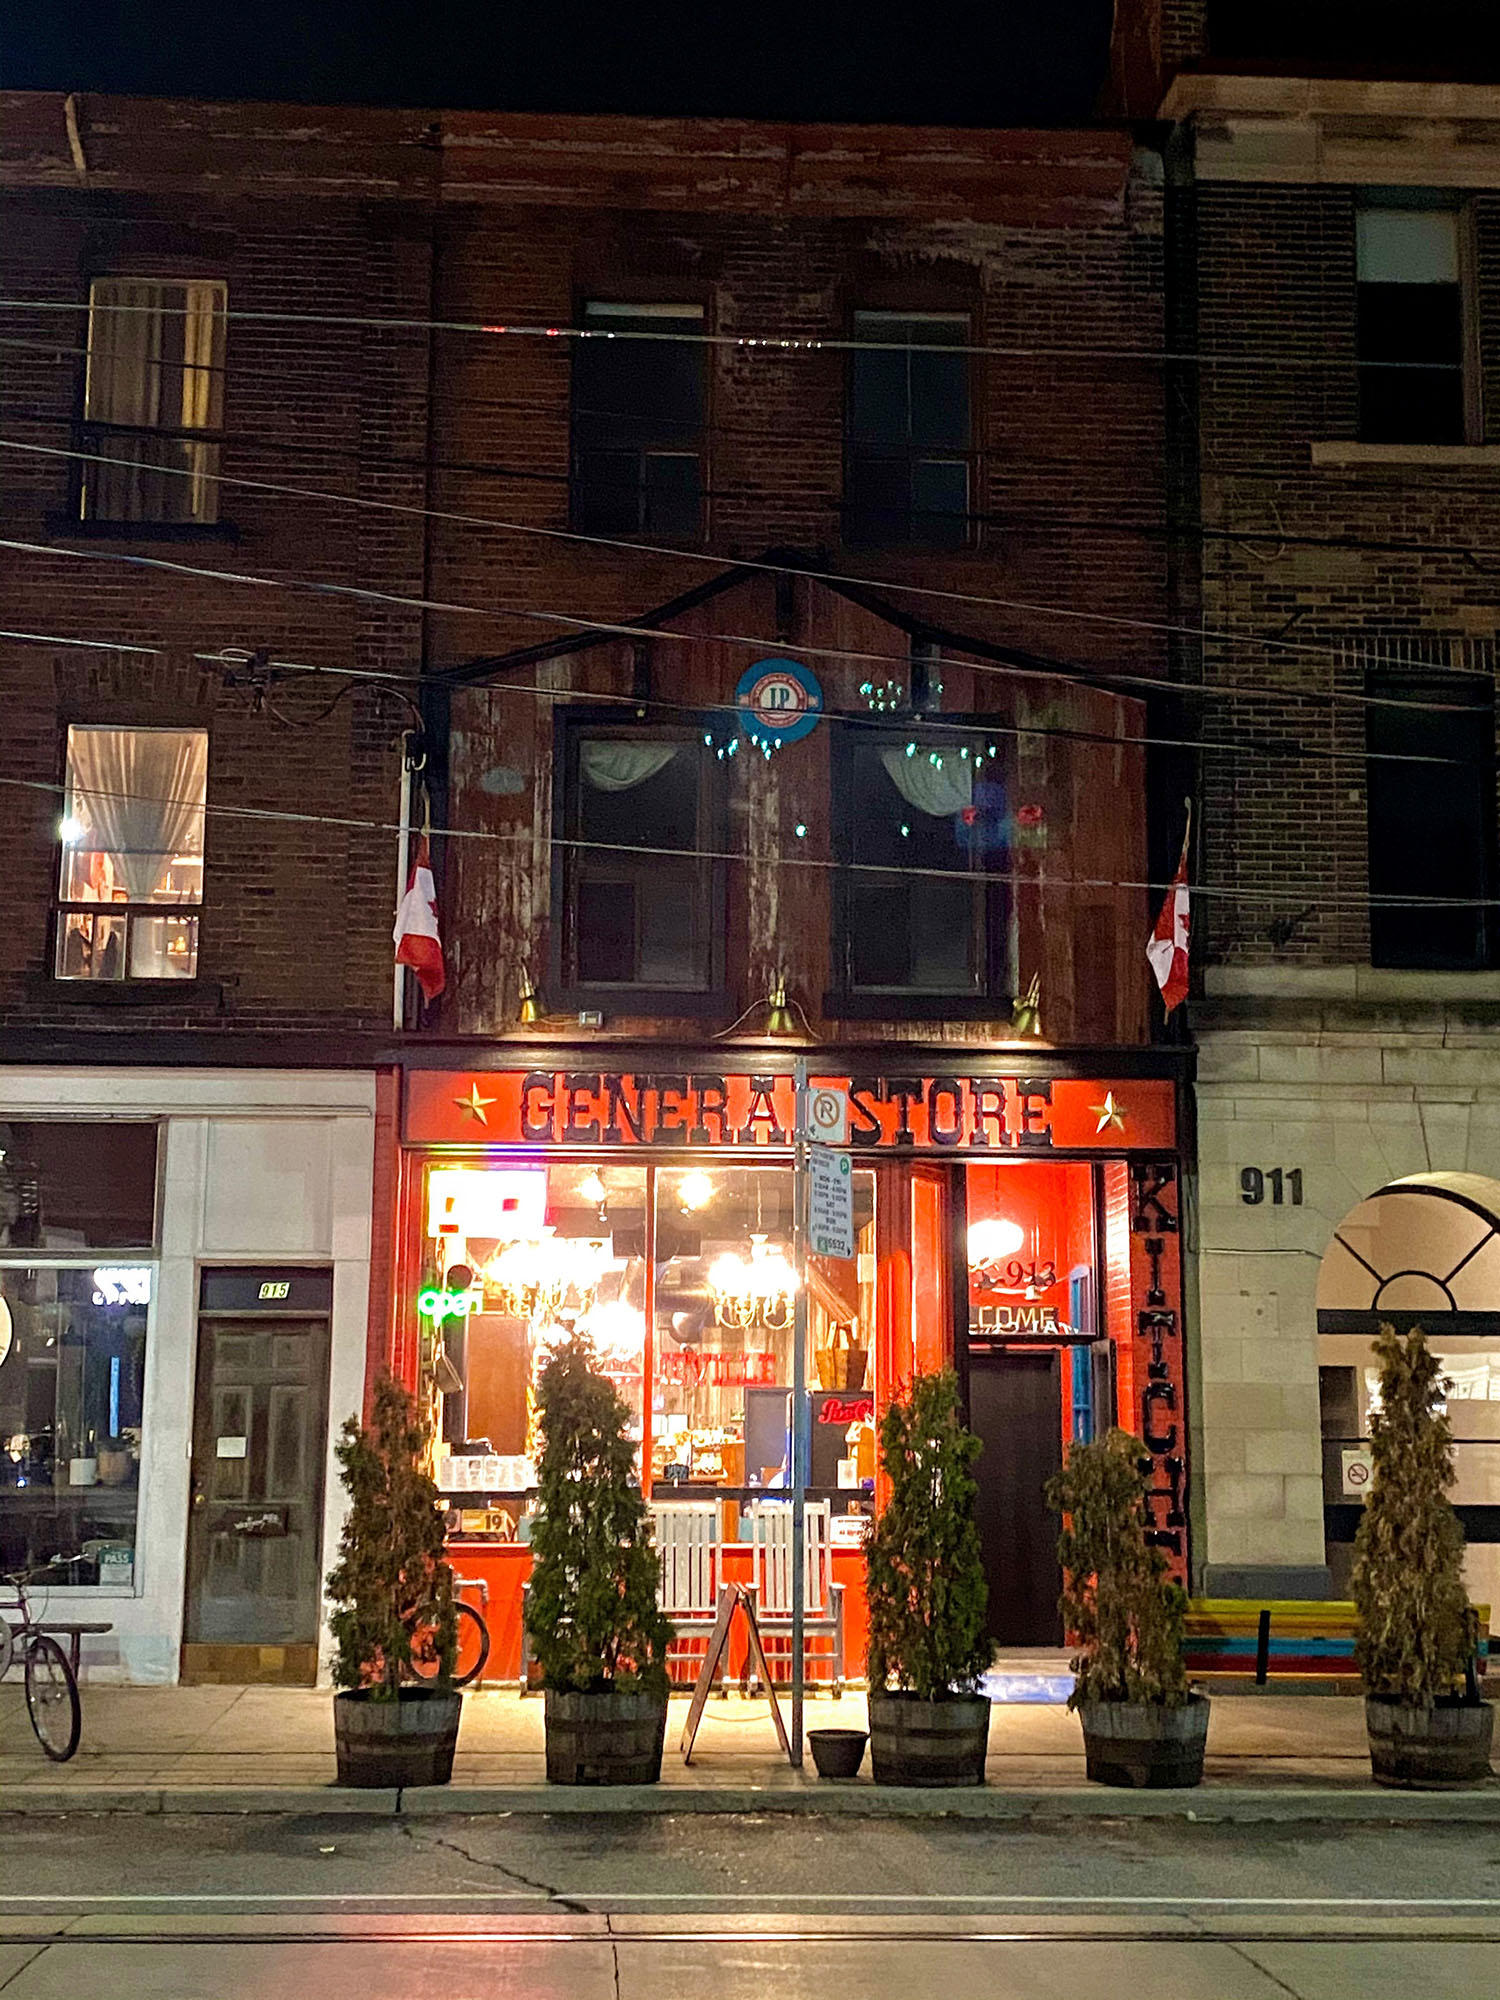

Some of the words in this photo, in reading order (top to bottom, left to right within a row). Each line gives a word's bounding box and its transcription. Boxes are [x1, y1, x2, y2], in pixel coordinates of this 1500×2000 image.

[520, 1070, 797, 1144] GENERA
[849, 1077, 1054, 1147] STORE
[1240, 1166, 1304, 1206] 911
[828, 1237, 845, 1251] 5532
[1006, 1260, 1057, 1288] 913
[261, 1283, 287, 1298] 915
[418, 1291, 483, 1327] open
[969, 1305, 1056, 1329] COME
[485, 1514, 503, 1531] 19
[104, 1552, 129, 1565] PASS
